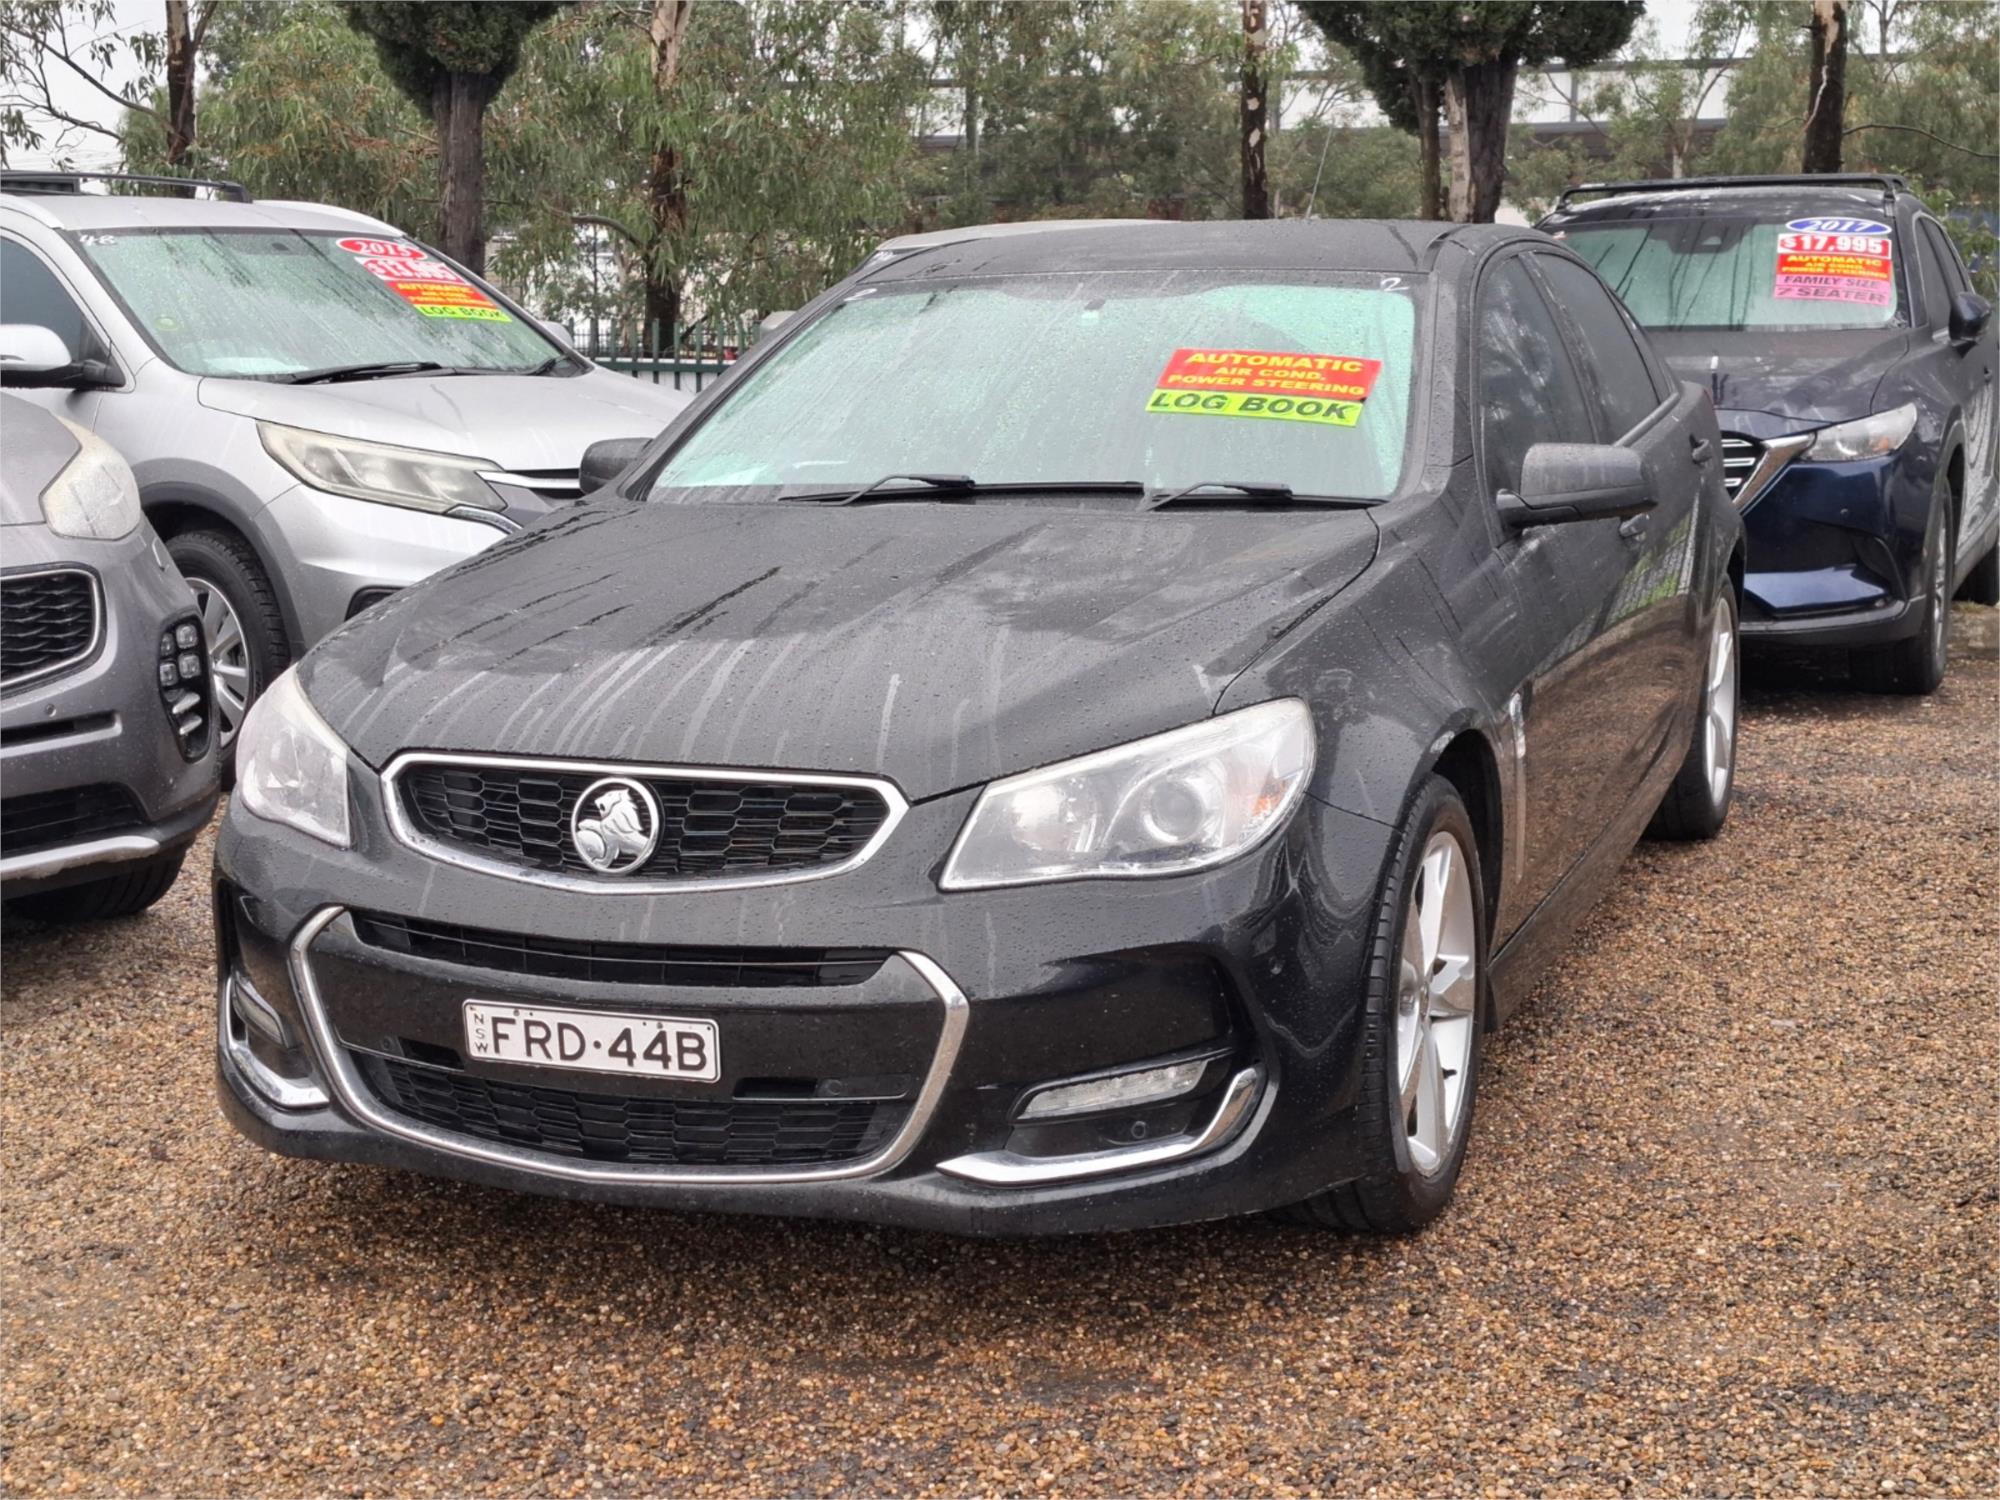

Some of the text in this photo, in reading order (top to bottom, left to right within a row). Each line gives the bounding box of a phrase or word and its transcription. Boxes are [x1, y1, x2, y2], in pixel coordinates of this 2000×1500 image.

[1806, 220, 1874, 232] 2017
[1787, 255, 1882, 267] AUTOMATIC
[1783, 276, 1881, 288] FAMILY SIZE
[1776, 287, 1886, 303] 7 SEATER
[1185, 352, 1366, 373] AUTOMATIC
[1214, 366, 1327, 381] AIR COND.
[1168, 374, 1367, 396] POWER STEERING
[1150, 392, 1356, 420] LOG BOOK
